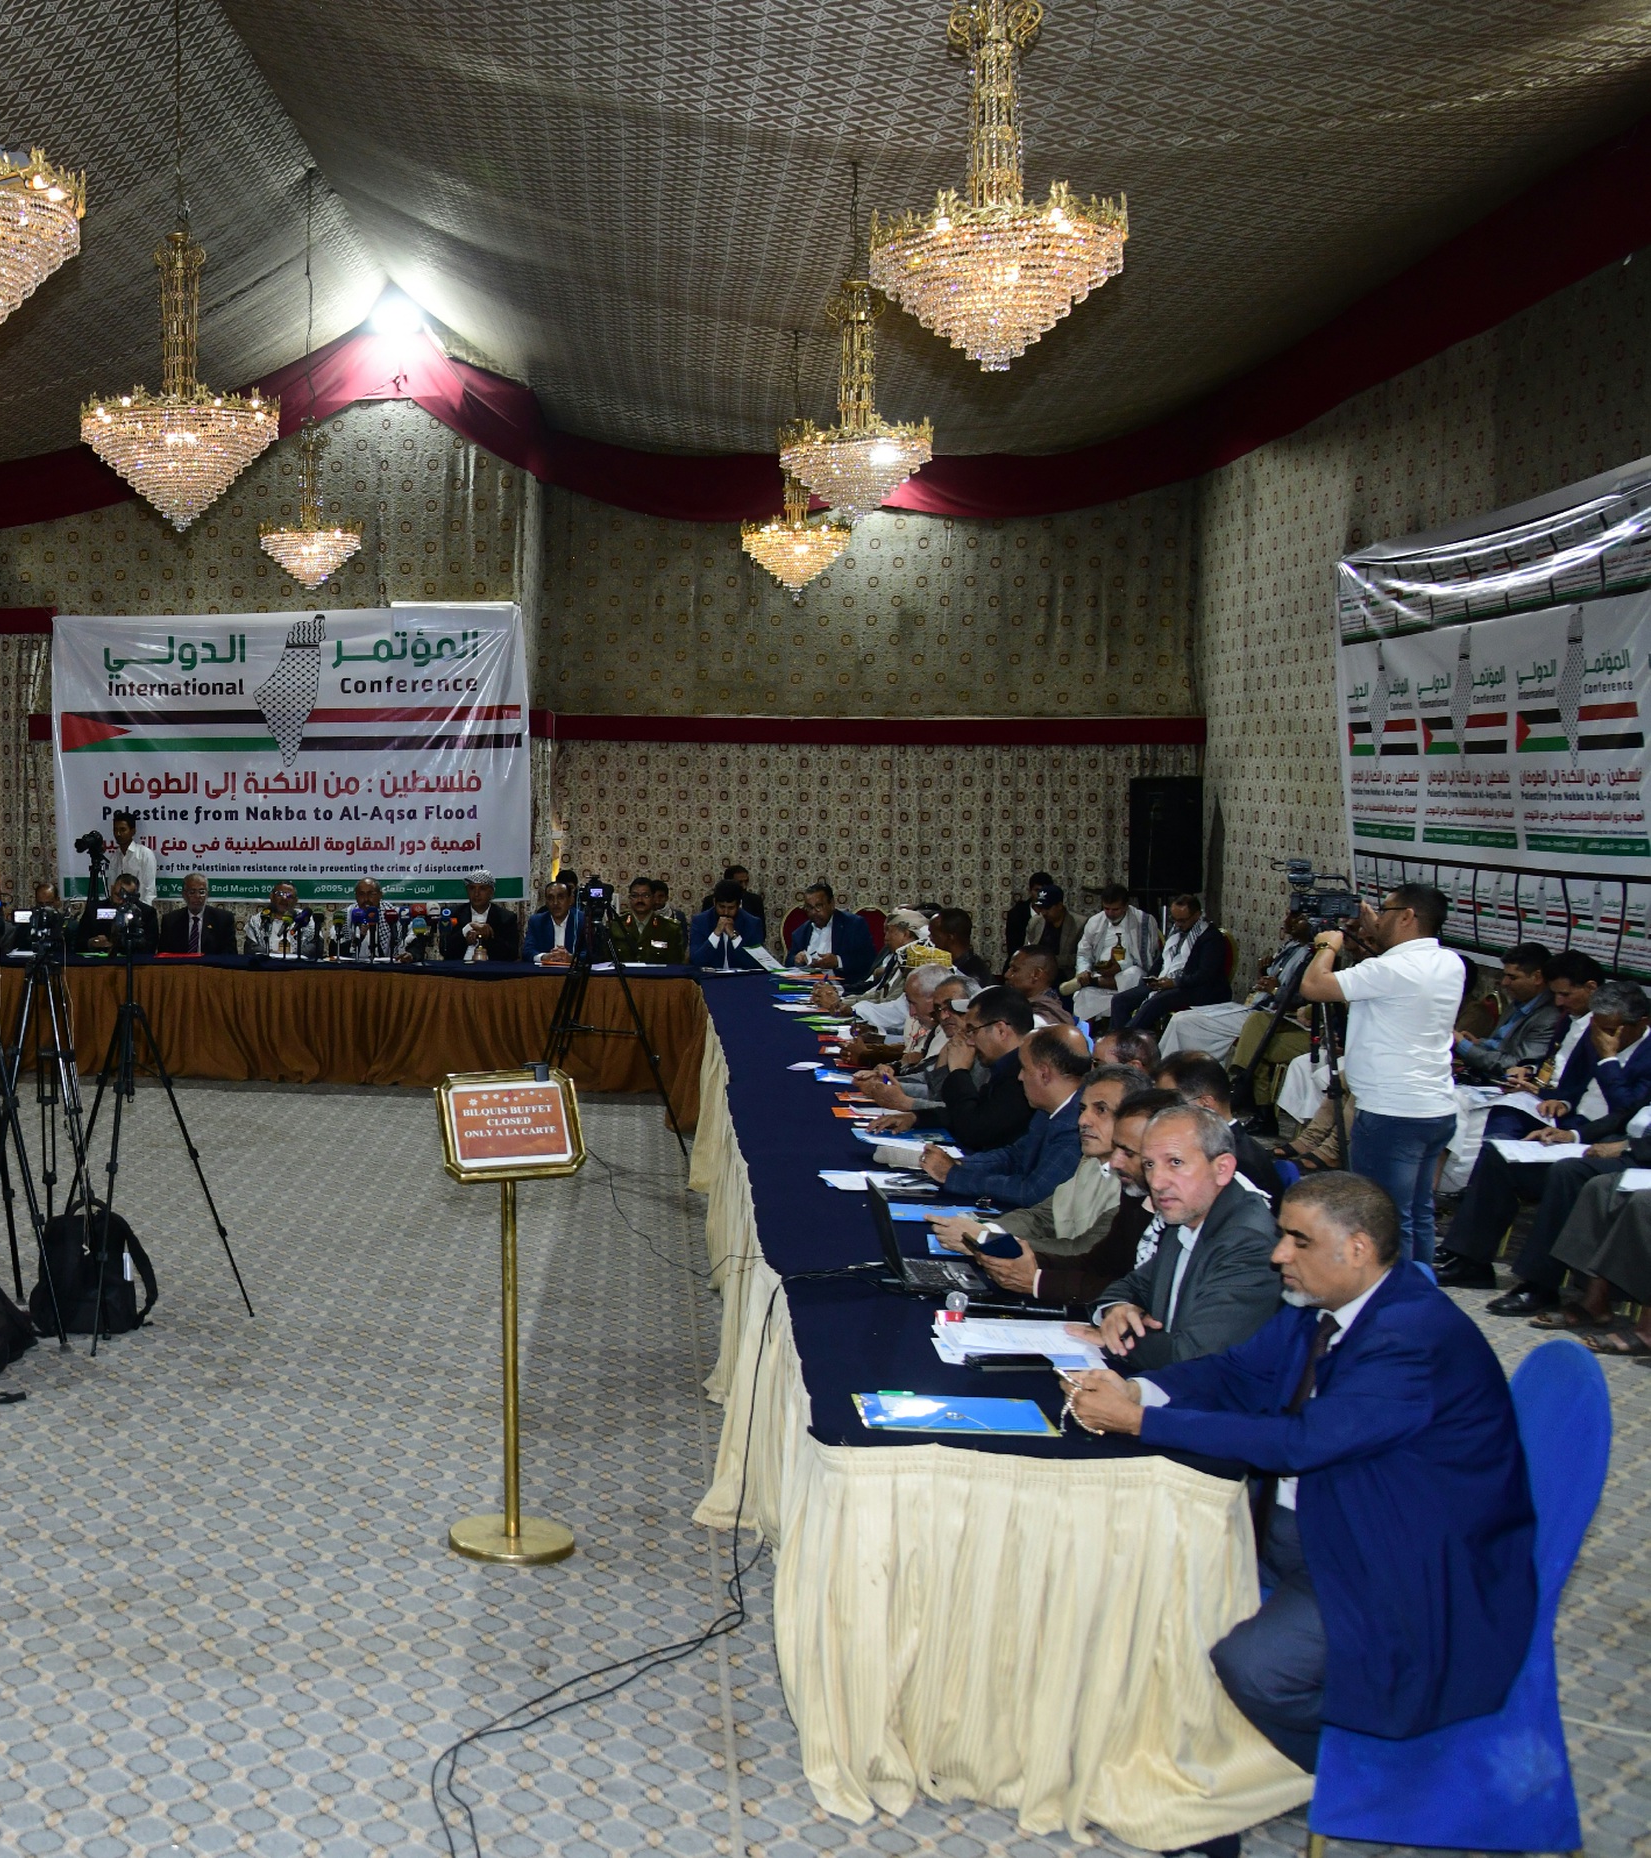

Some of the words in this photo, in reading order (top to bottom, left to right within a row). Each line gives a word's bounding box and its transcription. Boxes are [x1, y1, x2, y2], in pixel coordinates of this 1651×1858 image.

[104, 634, 245, 679] الدولي
[331, 629, 479, 669] المؤتمر
[108, 678, 245, 696] International
[340, 676, 478, 694] Conference
[1584, 681, 1633, 694] Conference
[103, 772, 198, 800] الطوفان
[205, 772, 237, 801] إلى
[243, 771, 317, 799] النكبة
[323, 771, 360, 799] من
[380, 770, 482, 798] فلسطين
[194, 806, 239, 824] from
[246, 806, 307, 821] Nakba
[314, 807, 333, 820] to
[339, 805, 417, 824] Al-Aqsa
[424, 805, 478, 820] Flood
[161, 837, 187, 856] منع
[192, 836, 220, 858] في
[224, 836, 320, 854] الفلسطينية
[324, 836, 394, 855] المقاومة
[399, 838, 426, 855] دور
[431, 833, 481, 854] أهمية
[166, 863, 174, 873] of
[177, 863, 190, 872] the
[192, 863, 240, 872] Palestinian
[243, 864, 288, 873] resistance
[290, 864, 307, 872] role
[308, 863, 317, 872] in
[320, 863, 368, 875] preventing
[370, 863, 384, 872] the
[386, 864, 411, 873] crime
[413, 864, 422, 874] of
[211, 884, 229, 893] 2nd
[230, 884, 260, 893] March
[462, 1106, 508, 1117] BILQUIS
[510, 1105, 552, 1114] BUFFET
[486, 1117, 531, 1126] CLOSED
[464, 1129, 493, 1138] ONLY
[495, 1129, 503, 1137] A
[505, 1128, 519, 1136] LA
[521, 1126, 557, 1135] CARTE
